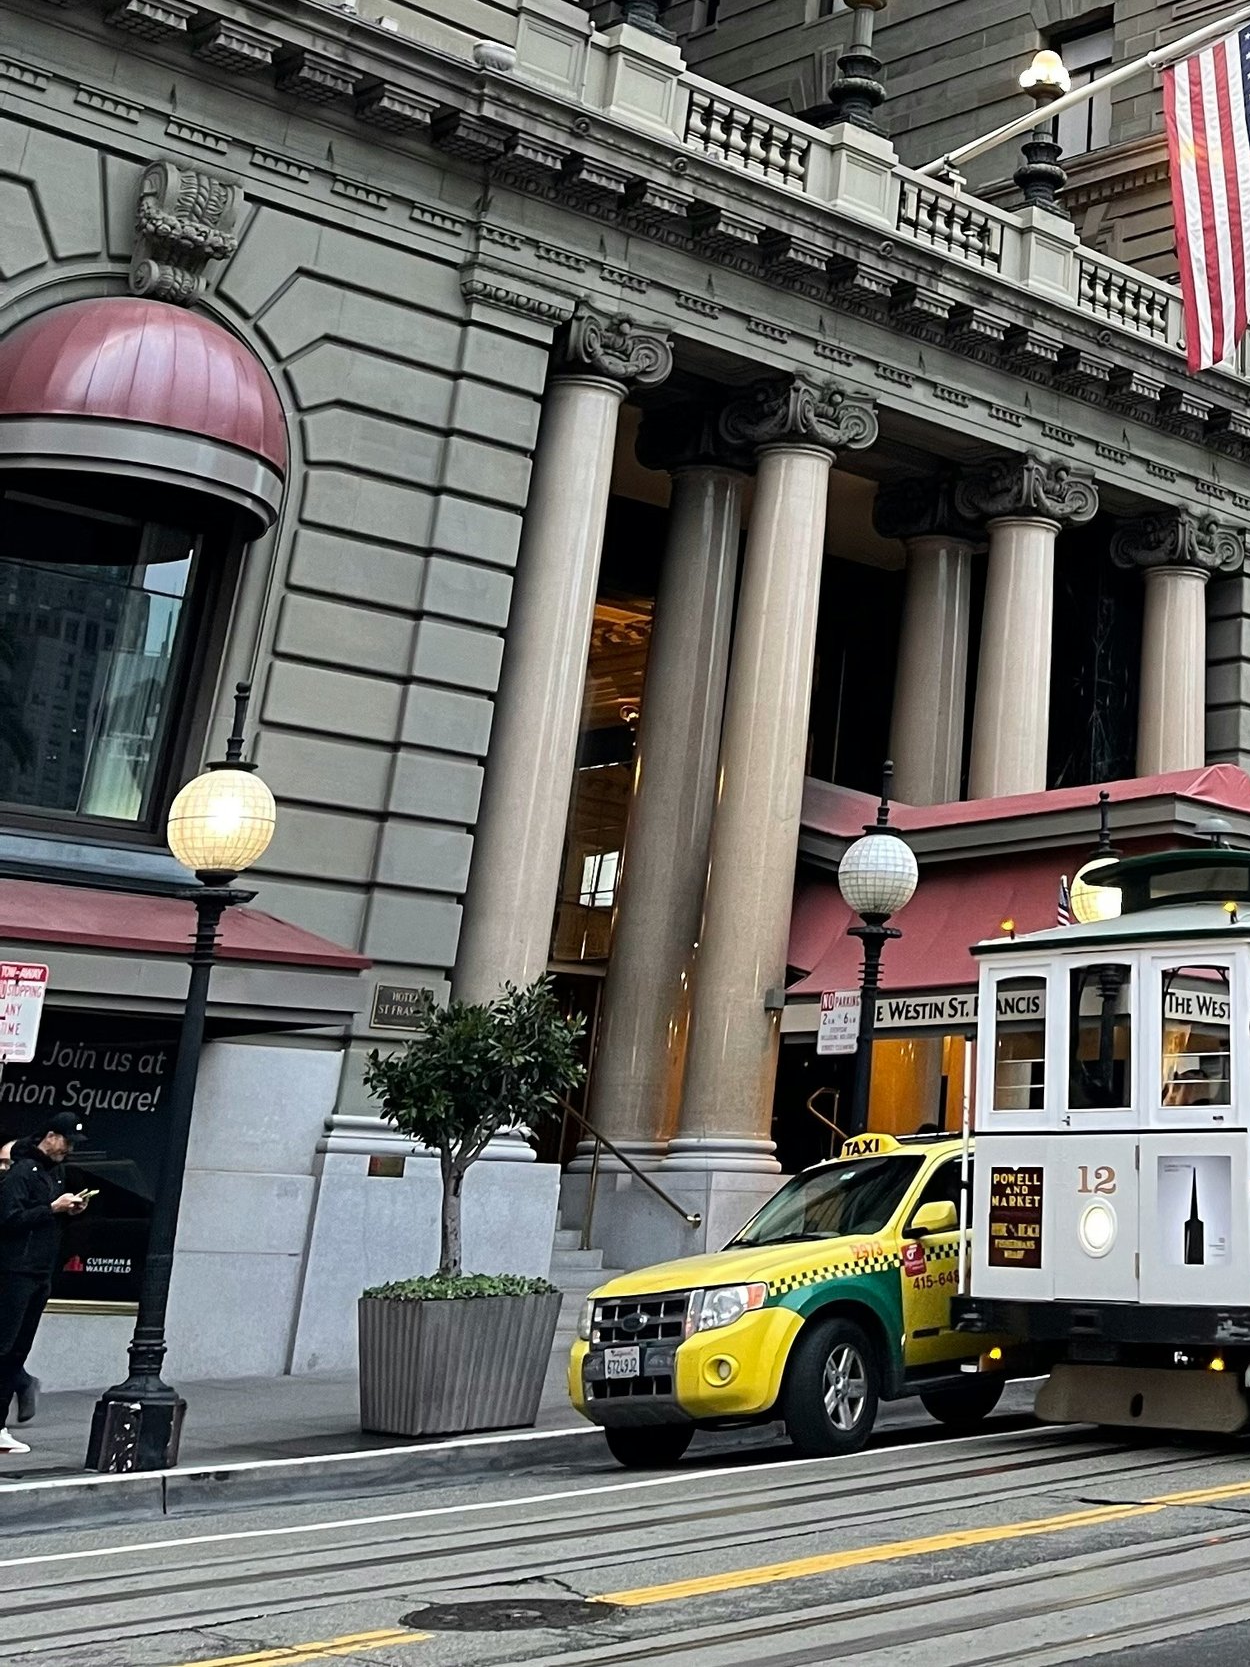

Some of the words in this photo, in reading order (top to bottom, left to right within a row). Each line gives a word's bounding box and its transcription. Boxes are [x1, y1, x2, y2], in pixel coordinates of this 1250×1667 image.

[2, 965, 43, 979] TOW-AWAY
[7, 984, 42, 998] STOPPING
[823, 993, 835, 1010] NO
[1165, 992, 1193, 1015] THE
[5, 1004, 22, 1015] ANY
[889, 1000, 945, 1021] WESTIN
[948, 997, 969, 1018] ST.
[1, 1022, 21, 1036] TIME
[42, 1041, 97, 1069] Join
[103, 1051, 133, 1072] us
[138, 1051, 167, 1074] at
[0, 1076, 56, 1106] nion
[61, 1080, 162, 1116] Square!
[844, 1138, 880, 1157] TAXI
[993, 1173, 1041, 1185] POWELL
[1077, 1165, 1117, 1195] 12
[1005, 1186, 1029, 1194] AND
[991, 1195, 1041, 1208] MARKET
[86, 1257, 125, 1265] CUSHMAN
[85, 1265, 131, 1273] WAKEFIELD
